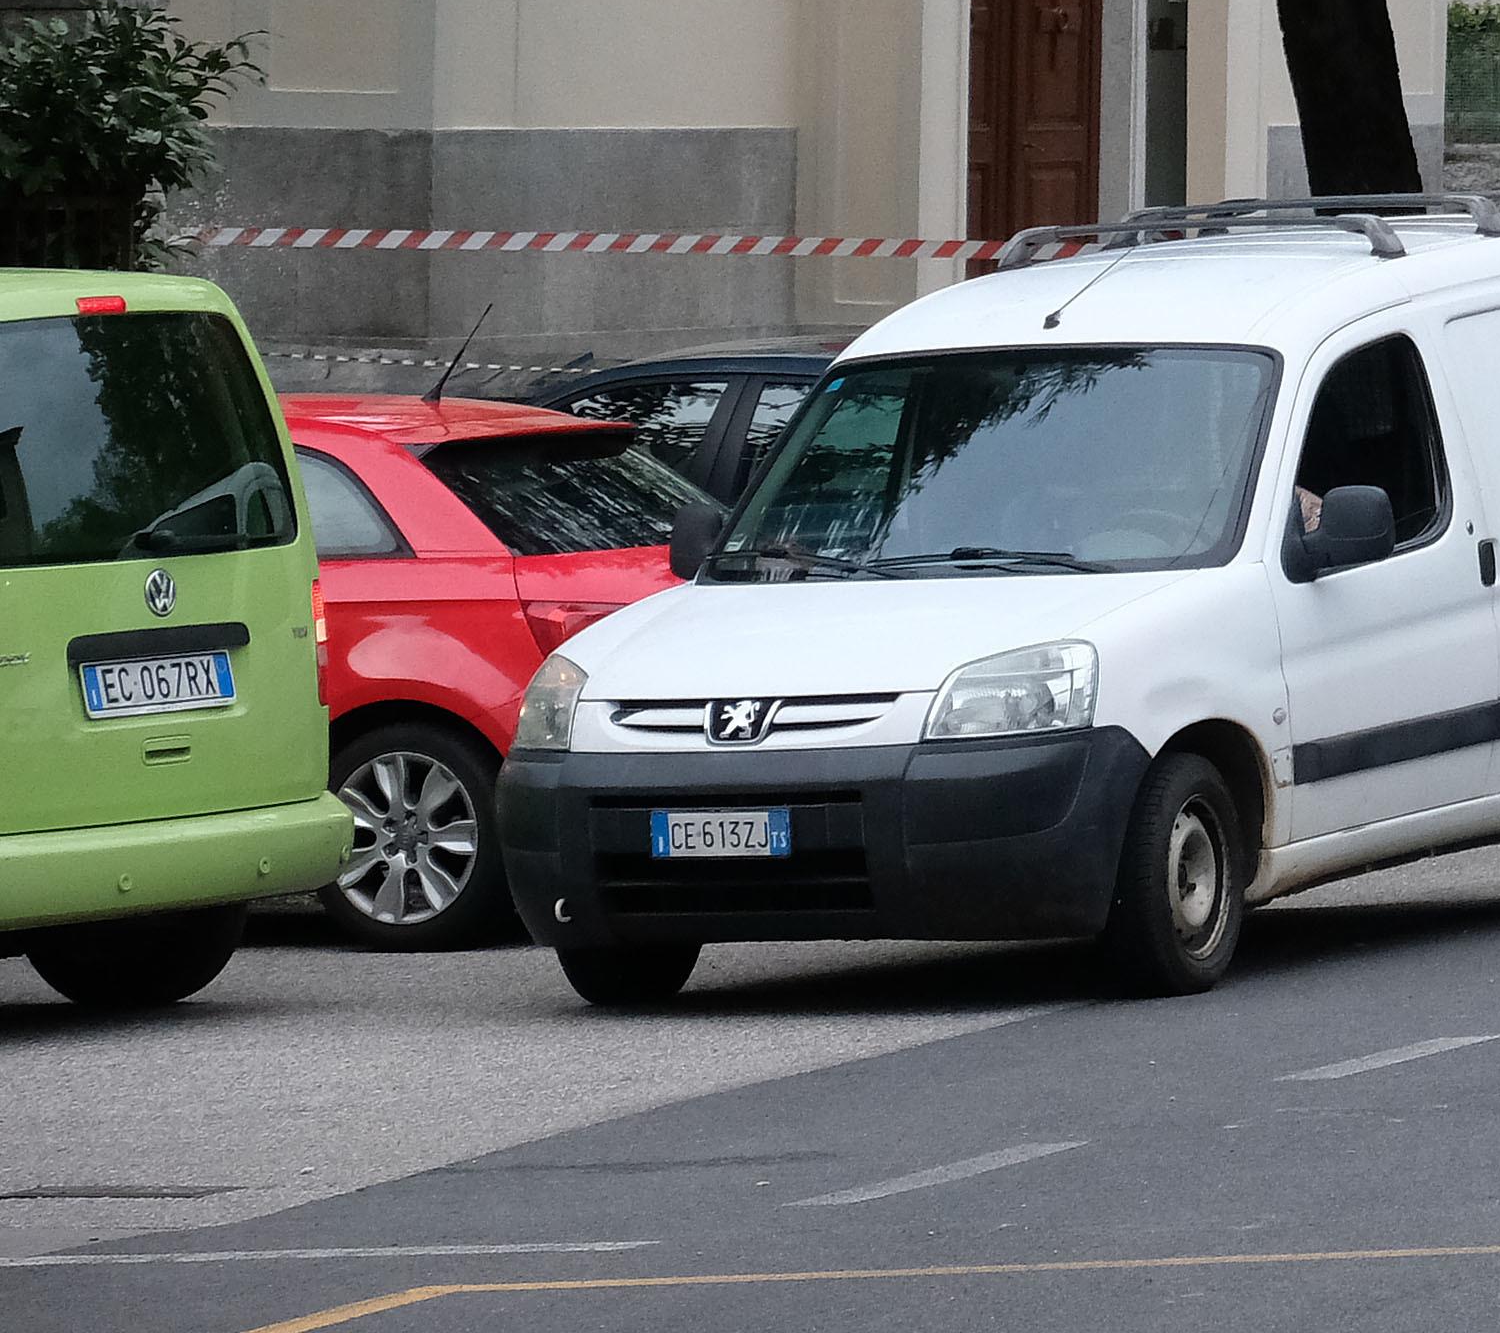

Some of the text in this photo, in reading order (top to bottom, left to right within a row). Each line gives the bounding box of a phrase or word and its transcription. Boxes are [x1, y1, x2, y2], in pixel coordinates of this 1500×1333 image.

[101, 667, 134, 704] EC
[140, 657, 218, 701] 067RX
[671, 822, 696, 850] CE
[702, 821, 769, 849] 613ZJ
[771, 831, 787, 848] TS
